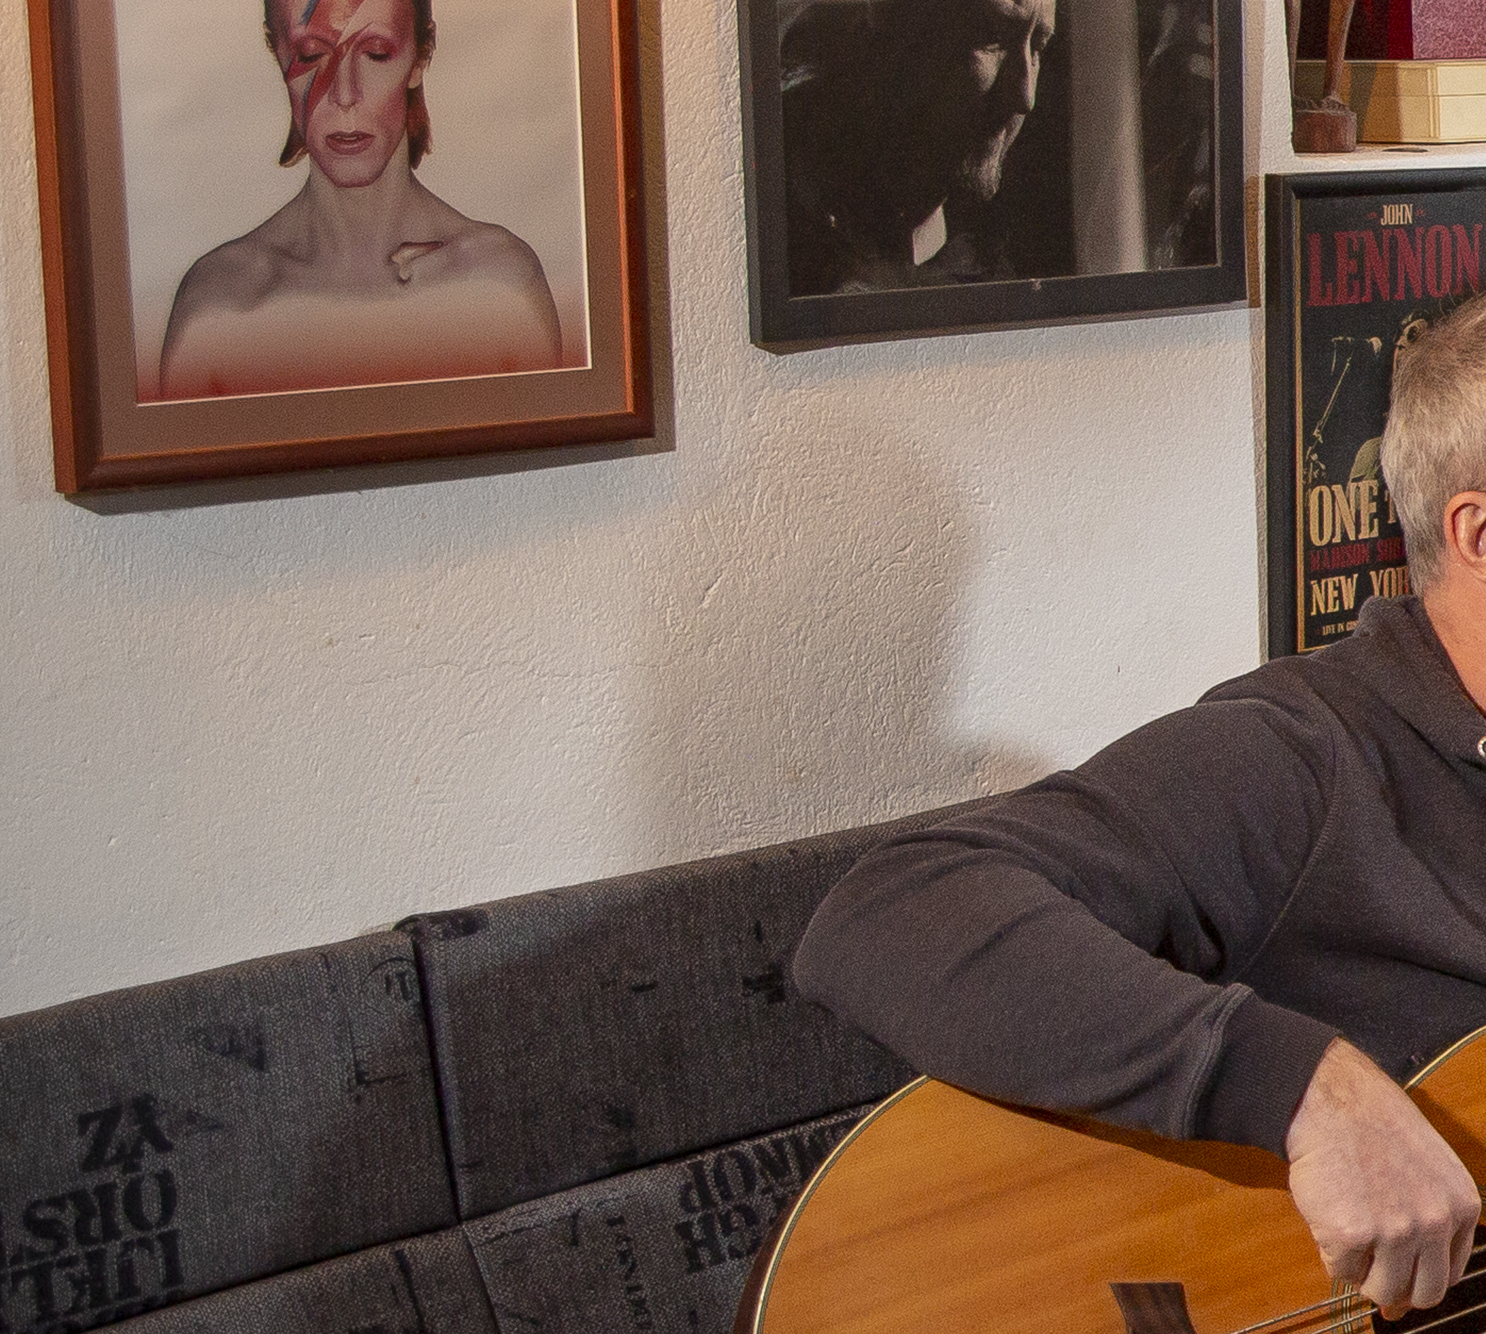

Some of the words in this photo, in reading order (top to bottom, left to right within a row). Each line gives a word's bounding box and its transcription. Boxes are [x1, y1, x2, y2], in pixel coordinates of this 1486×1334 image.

[1381, 204, 1413, 225] JOHN
[1305, 224, 1484, 307] LENNON
[1309, 479, 1379, 547] ONE
[1310, 573, 1358, 616] NEW
[1369, 565, 1412, 598] YOR
